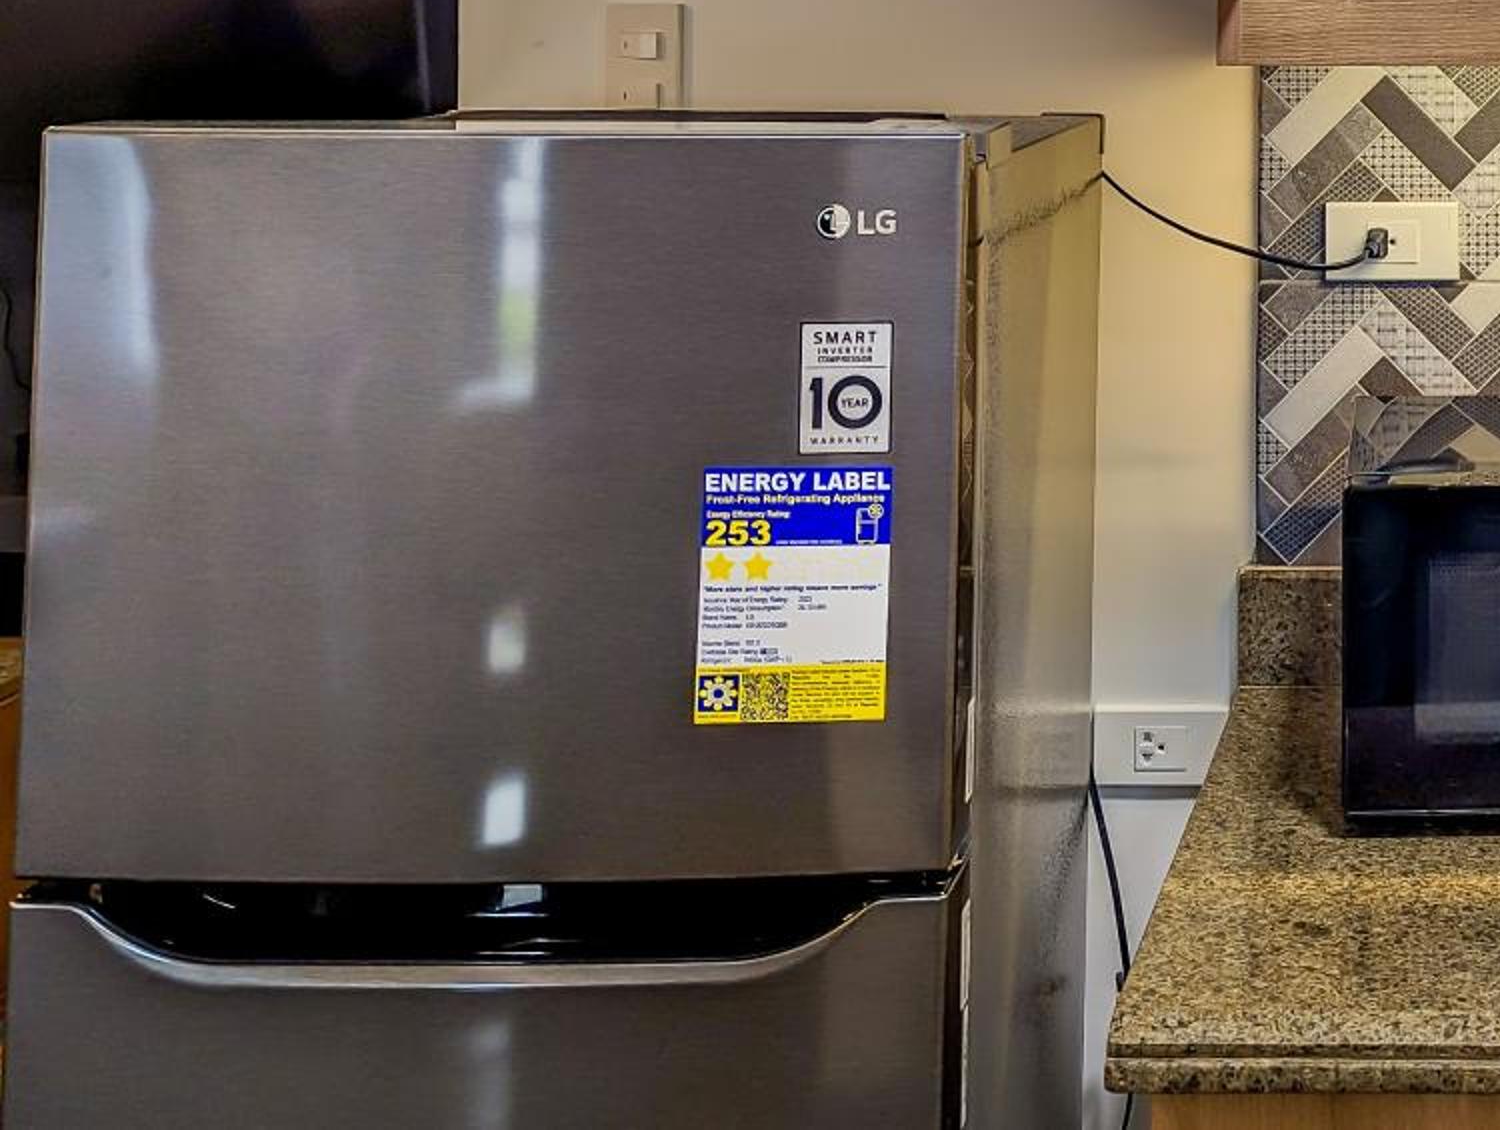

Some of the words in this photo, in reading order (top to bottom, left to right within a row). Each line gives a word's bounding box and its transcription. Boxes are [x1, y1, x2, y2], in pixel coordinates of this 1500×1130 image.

[857, 209, 897, 235] LG
[813, 331, 877, 344] SMART
[817, 347, 873, 355] INVERTER
[809, 375, 883, 430] 10
[841, 397, 869, 409] YEAR
[809, 435, 879, 445] WARRANTY
[705, 472, 806, 492] ENERGY
[813, 471, 891, 491] LABEL
[706, 494, 761, 504] Frost-Free
[763, 494, 831, 506] Refrigerating
[833, 493, 885, 505] Appliance
[705, 520, 772, 547] 253
